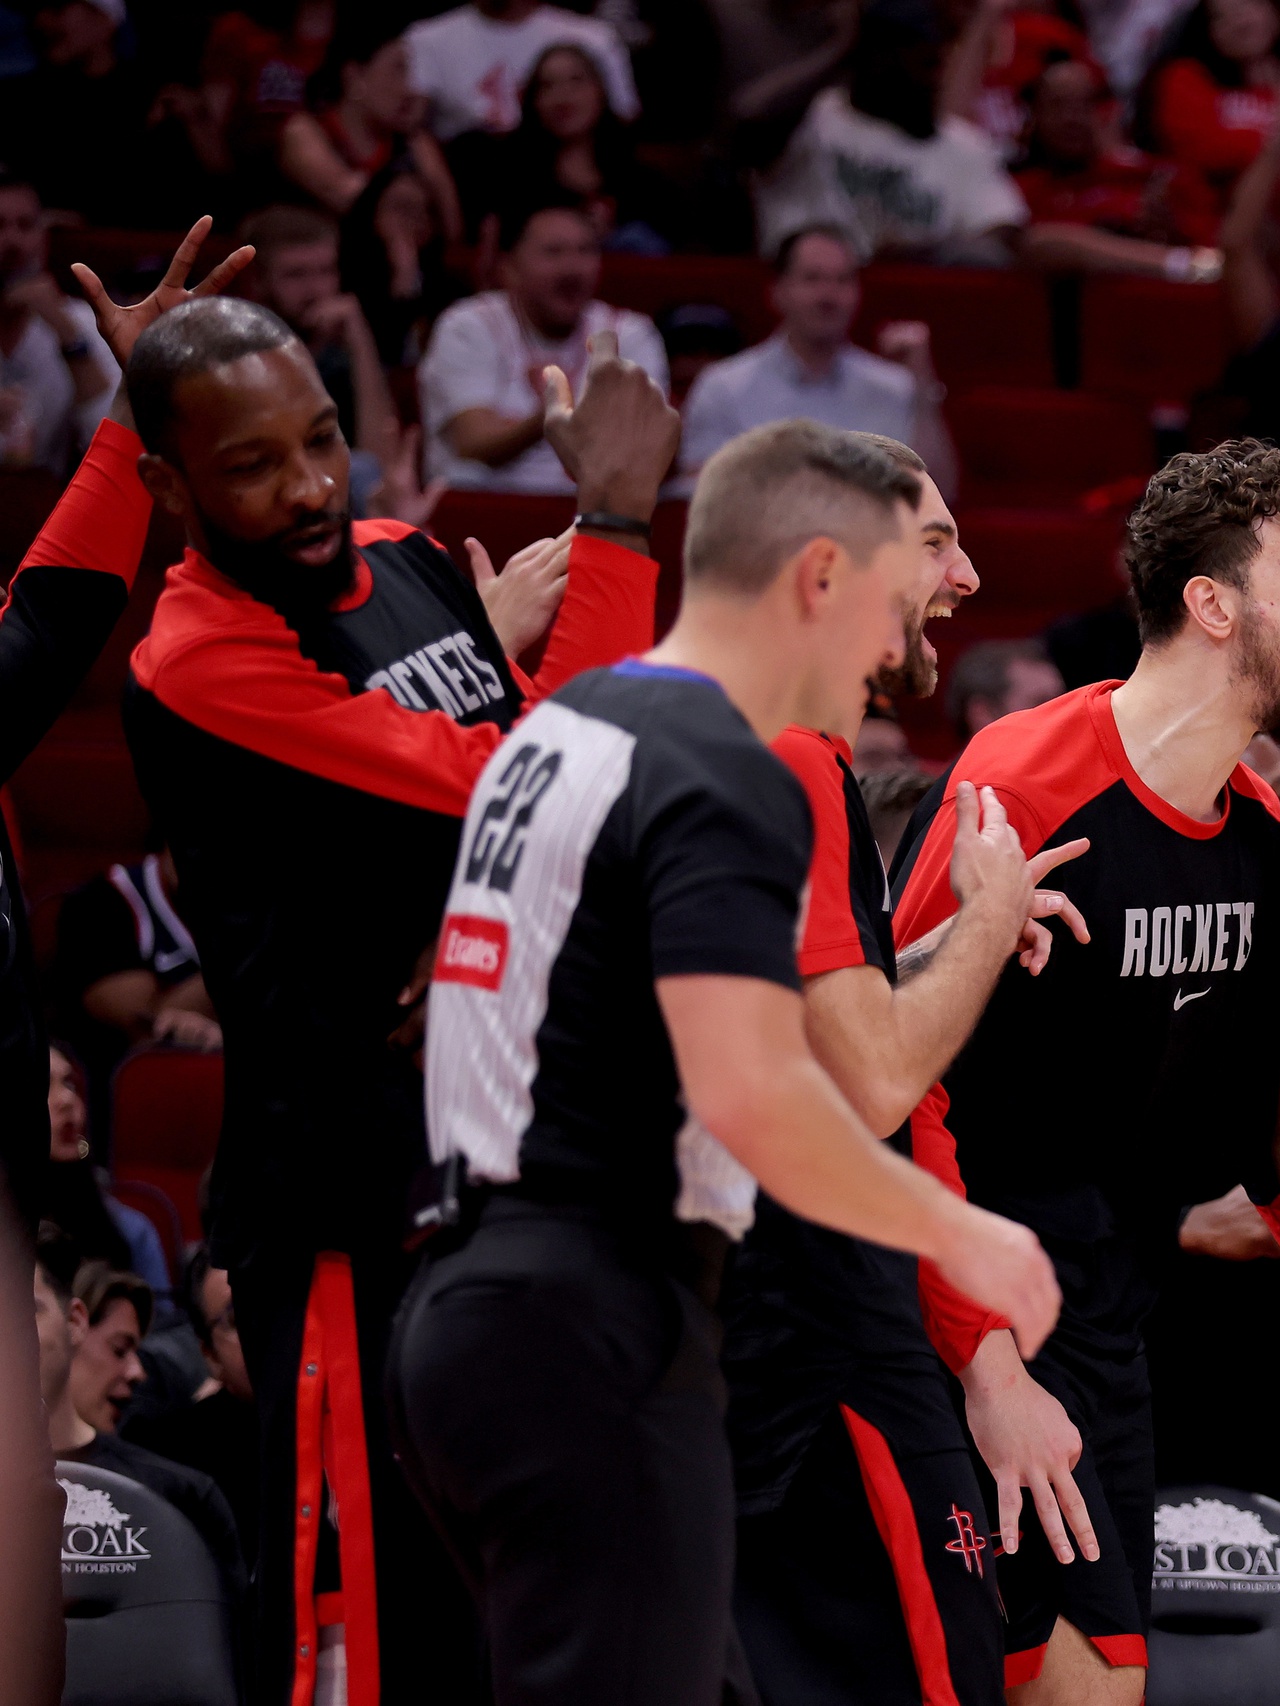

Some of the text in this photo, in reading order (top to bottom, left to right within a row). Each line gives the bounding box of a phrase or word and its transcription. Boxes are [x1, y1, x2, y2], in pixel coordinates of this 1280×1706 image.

[365, 631, 505, 719] OCKETS
[465, 741, 563, 893] 22
[67, 1526, 149, 1555] OAK
[75, 1562, 137, 1574] HOUSTON
[1154, 1543, 1199, 1572] ST
